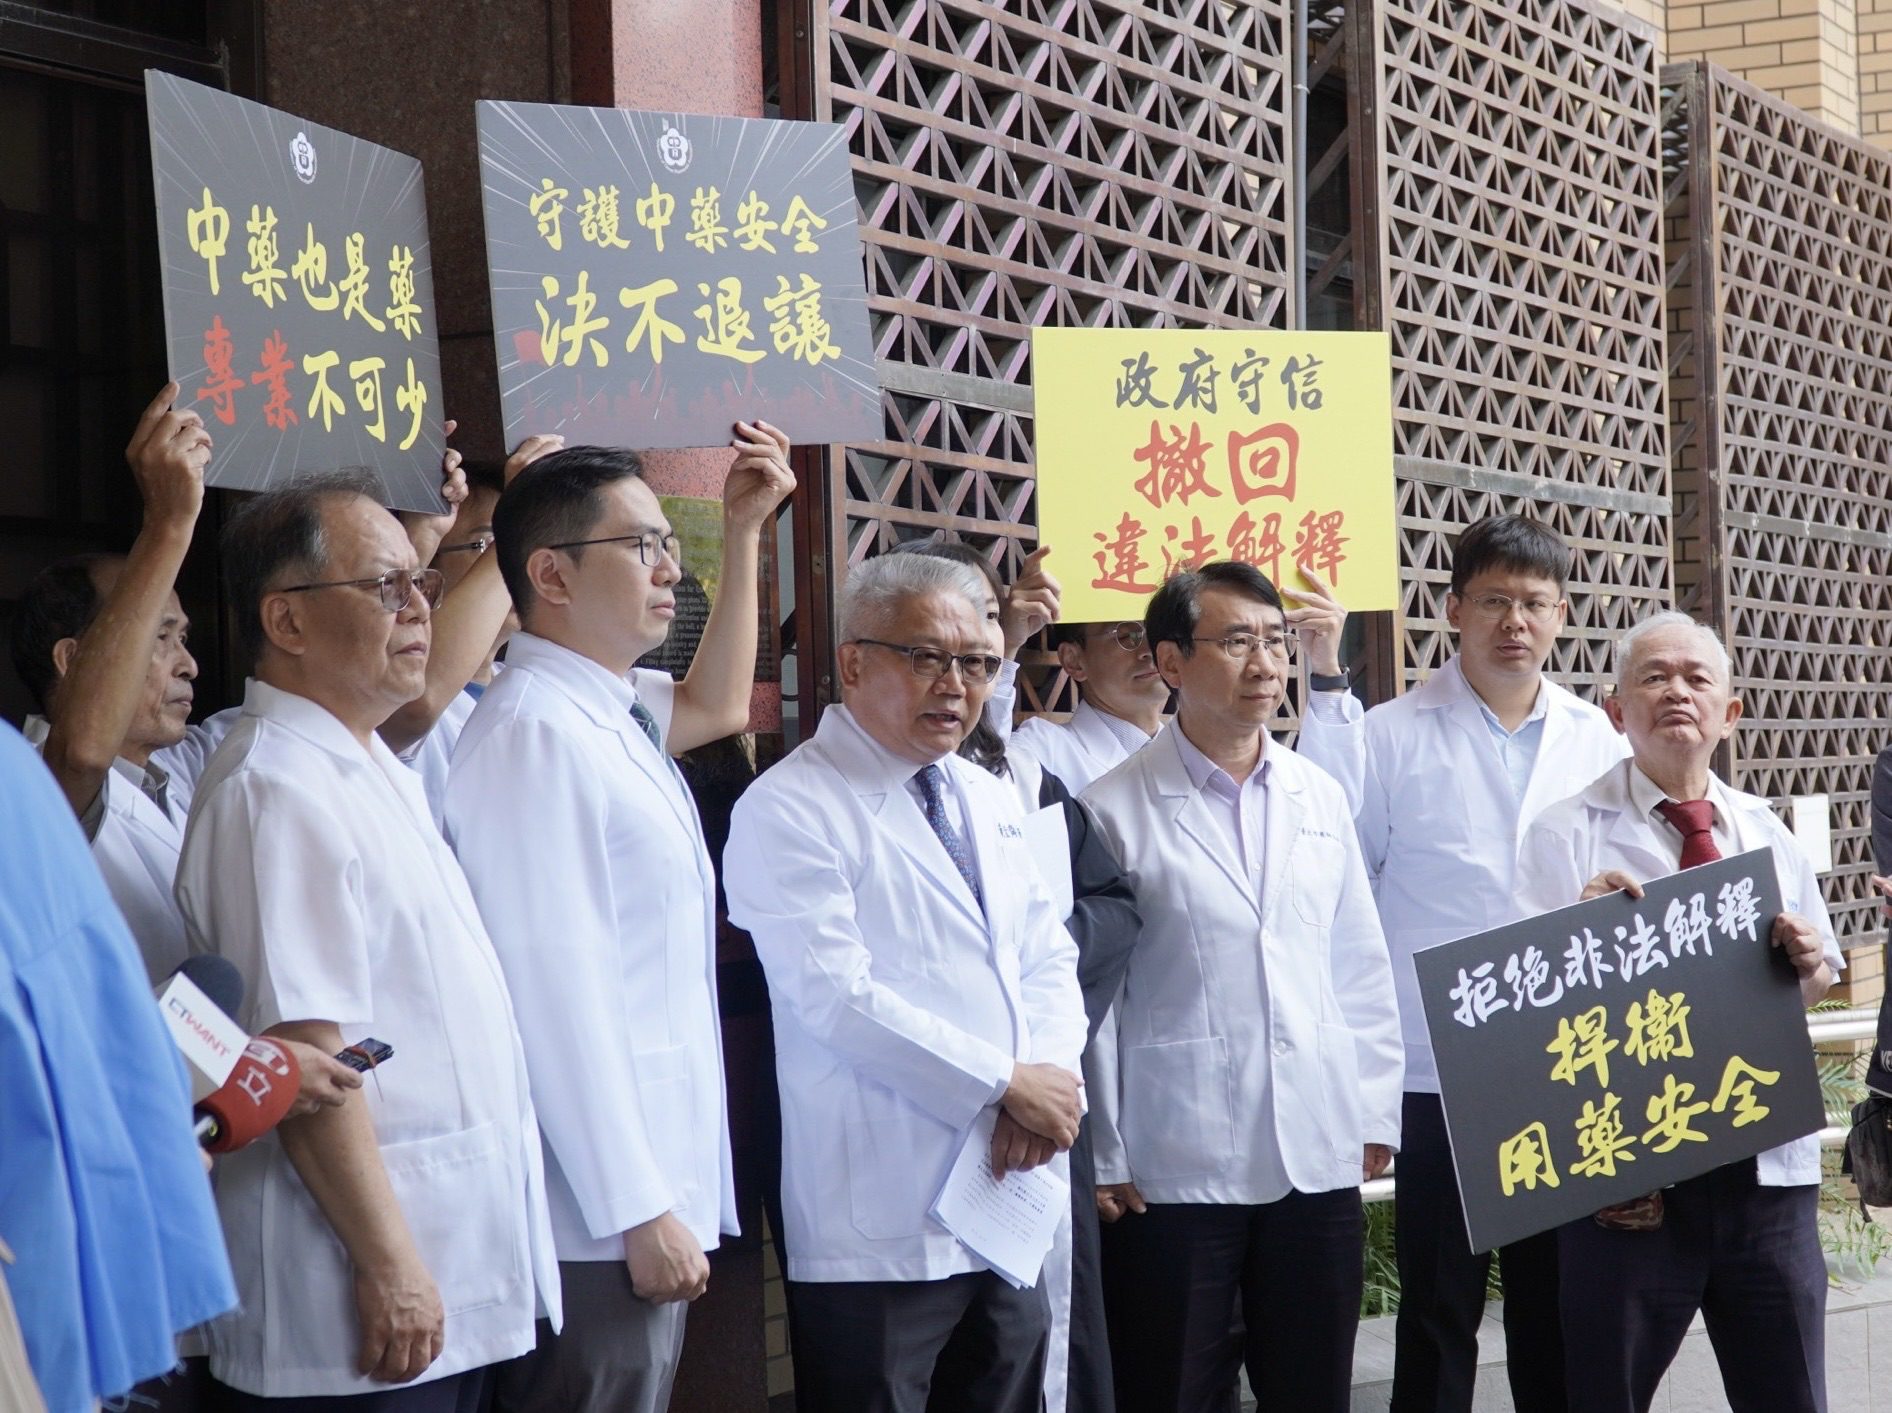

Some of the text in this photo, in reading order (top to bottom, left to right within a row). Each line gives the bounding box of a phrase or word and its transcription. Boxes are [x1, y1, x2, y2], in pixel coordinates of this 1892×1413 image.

[530, 177, 828, 254] 守護中藥安全
[187, 187, 423, 342] 中藥也是藥
[535, 270, 842, 367] 決不退讓
[197, 314, 428, 451] 專業不可少
[1115, 347, 1324, 415] 政府守信
[1133, 419, 1300, 508] 撤回
[1498, 1055, 1781, 1197] 用藥安全
